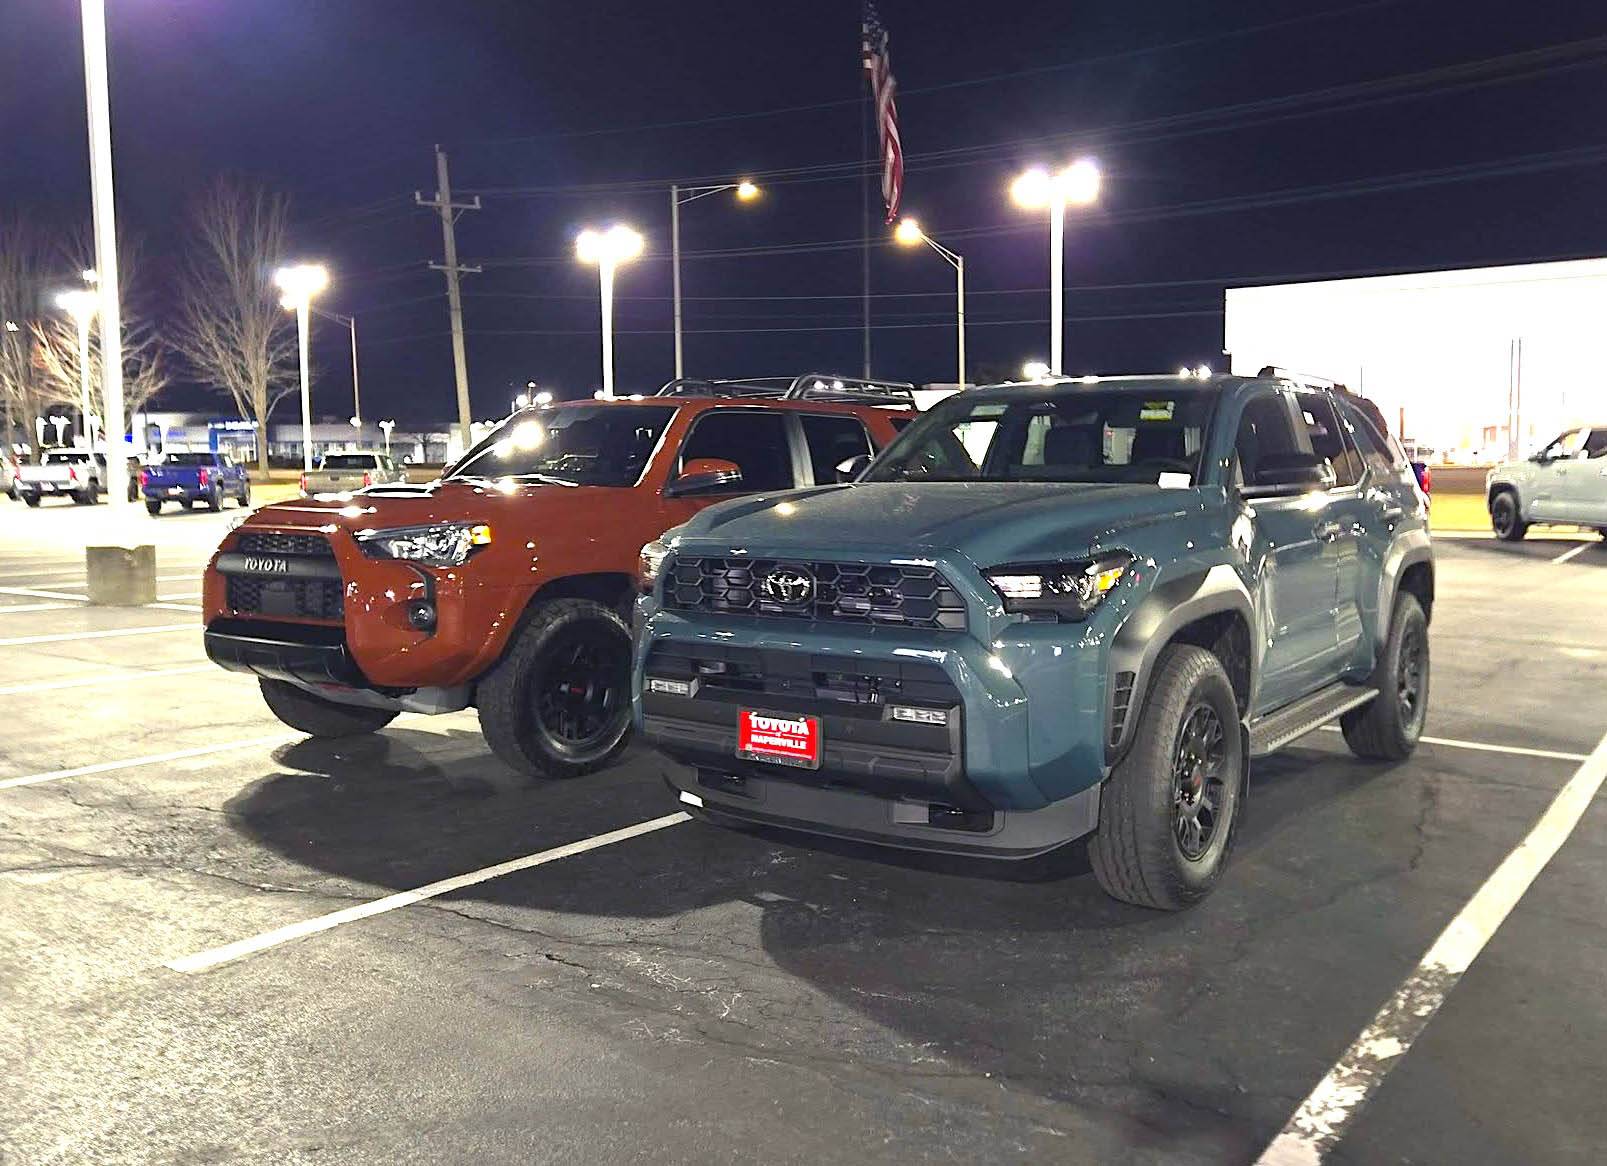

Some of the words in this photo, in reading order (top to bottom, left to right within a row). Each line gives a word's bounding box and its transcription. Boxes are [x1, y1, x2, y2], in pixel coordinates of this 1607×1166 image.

[244, 557, 286, 572] TOYOTA
[750, 715, 809, 735] TOYOTA
[751, 734, 806, 749] NAPERVILLE
